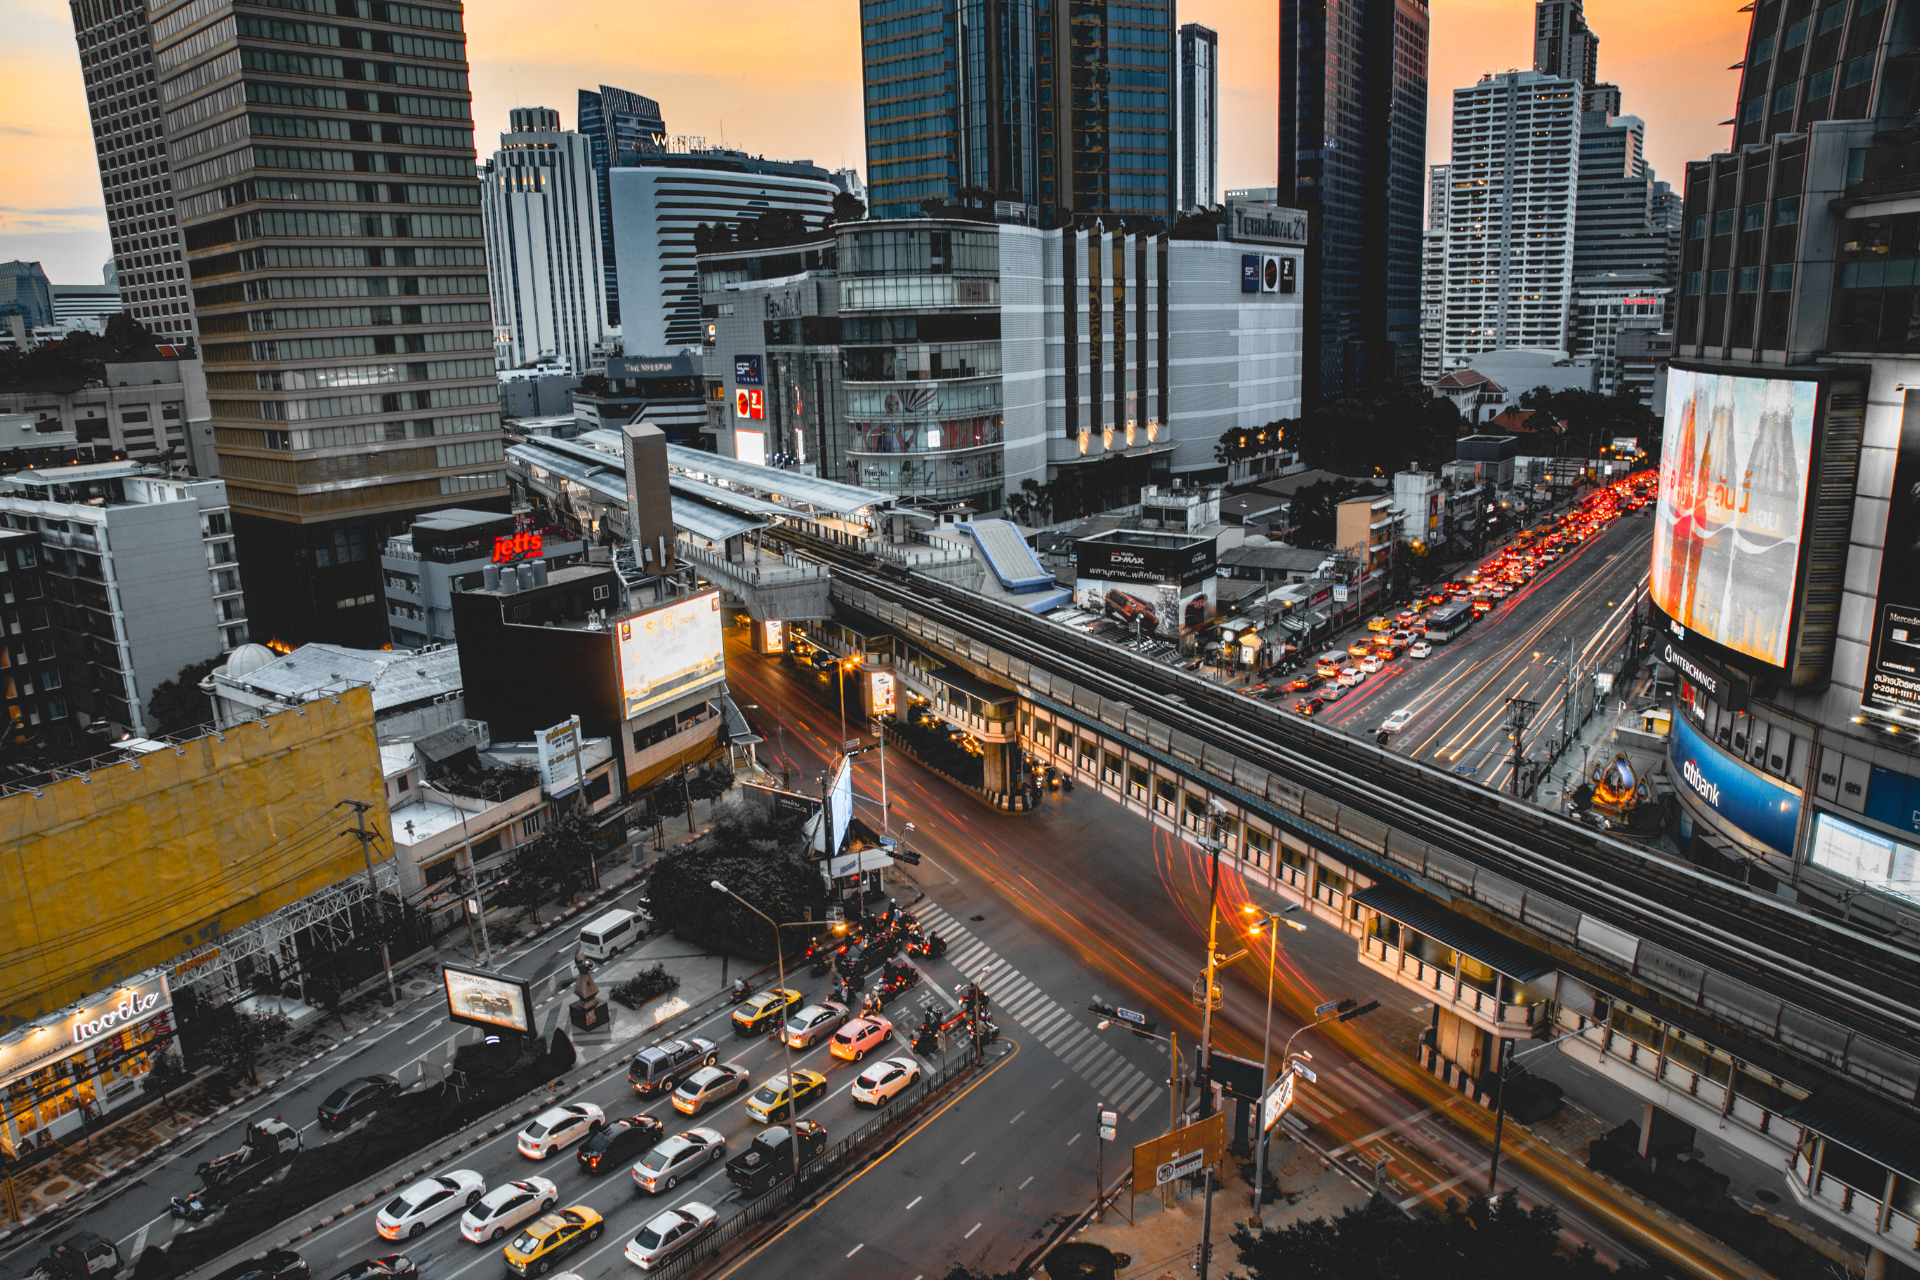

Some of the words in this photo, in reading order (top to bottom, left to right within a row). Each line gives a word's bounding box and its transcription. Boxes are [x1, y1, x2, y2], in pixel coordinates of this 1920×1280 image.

[651, 133, 706, 148] WESTIN
[492, 531, 542, 562] jetts
[1673, 652, 1716, 693] INTERCHANGE
[1873, 683, 1913, 700] 0-2081-1111
[1683, 760, 1720, 807] citibank
[73, 992, 160, 1044] Invite
